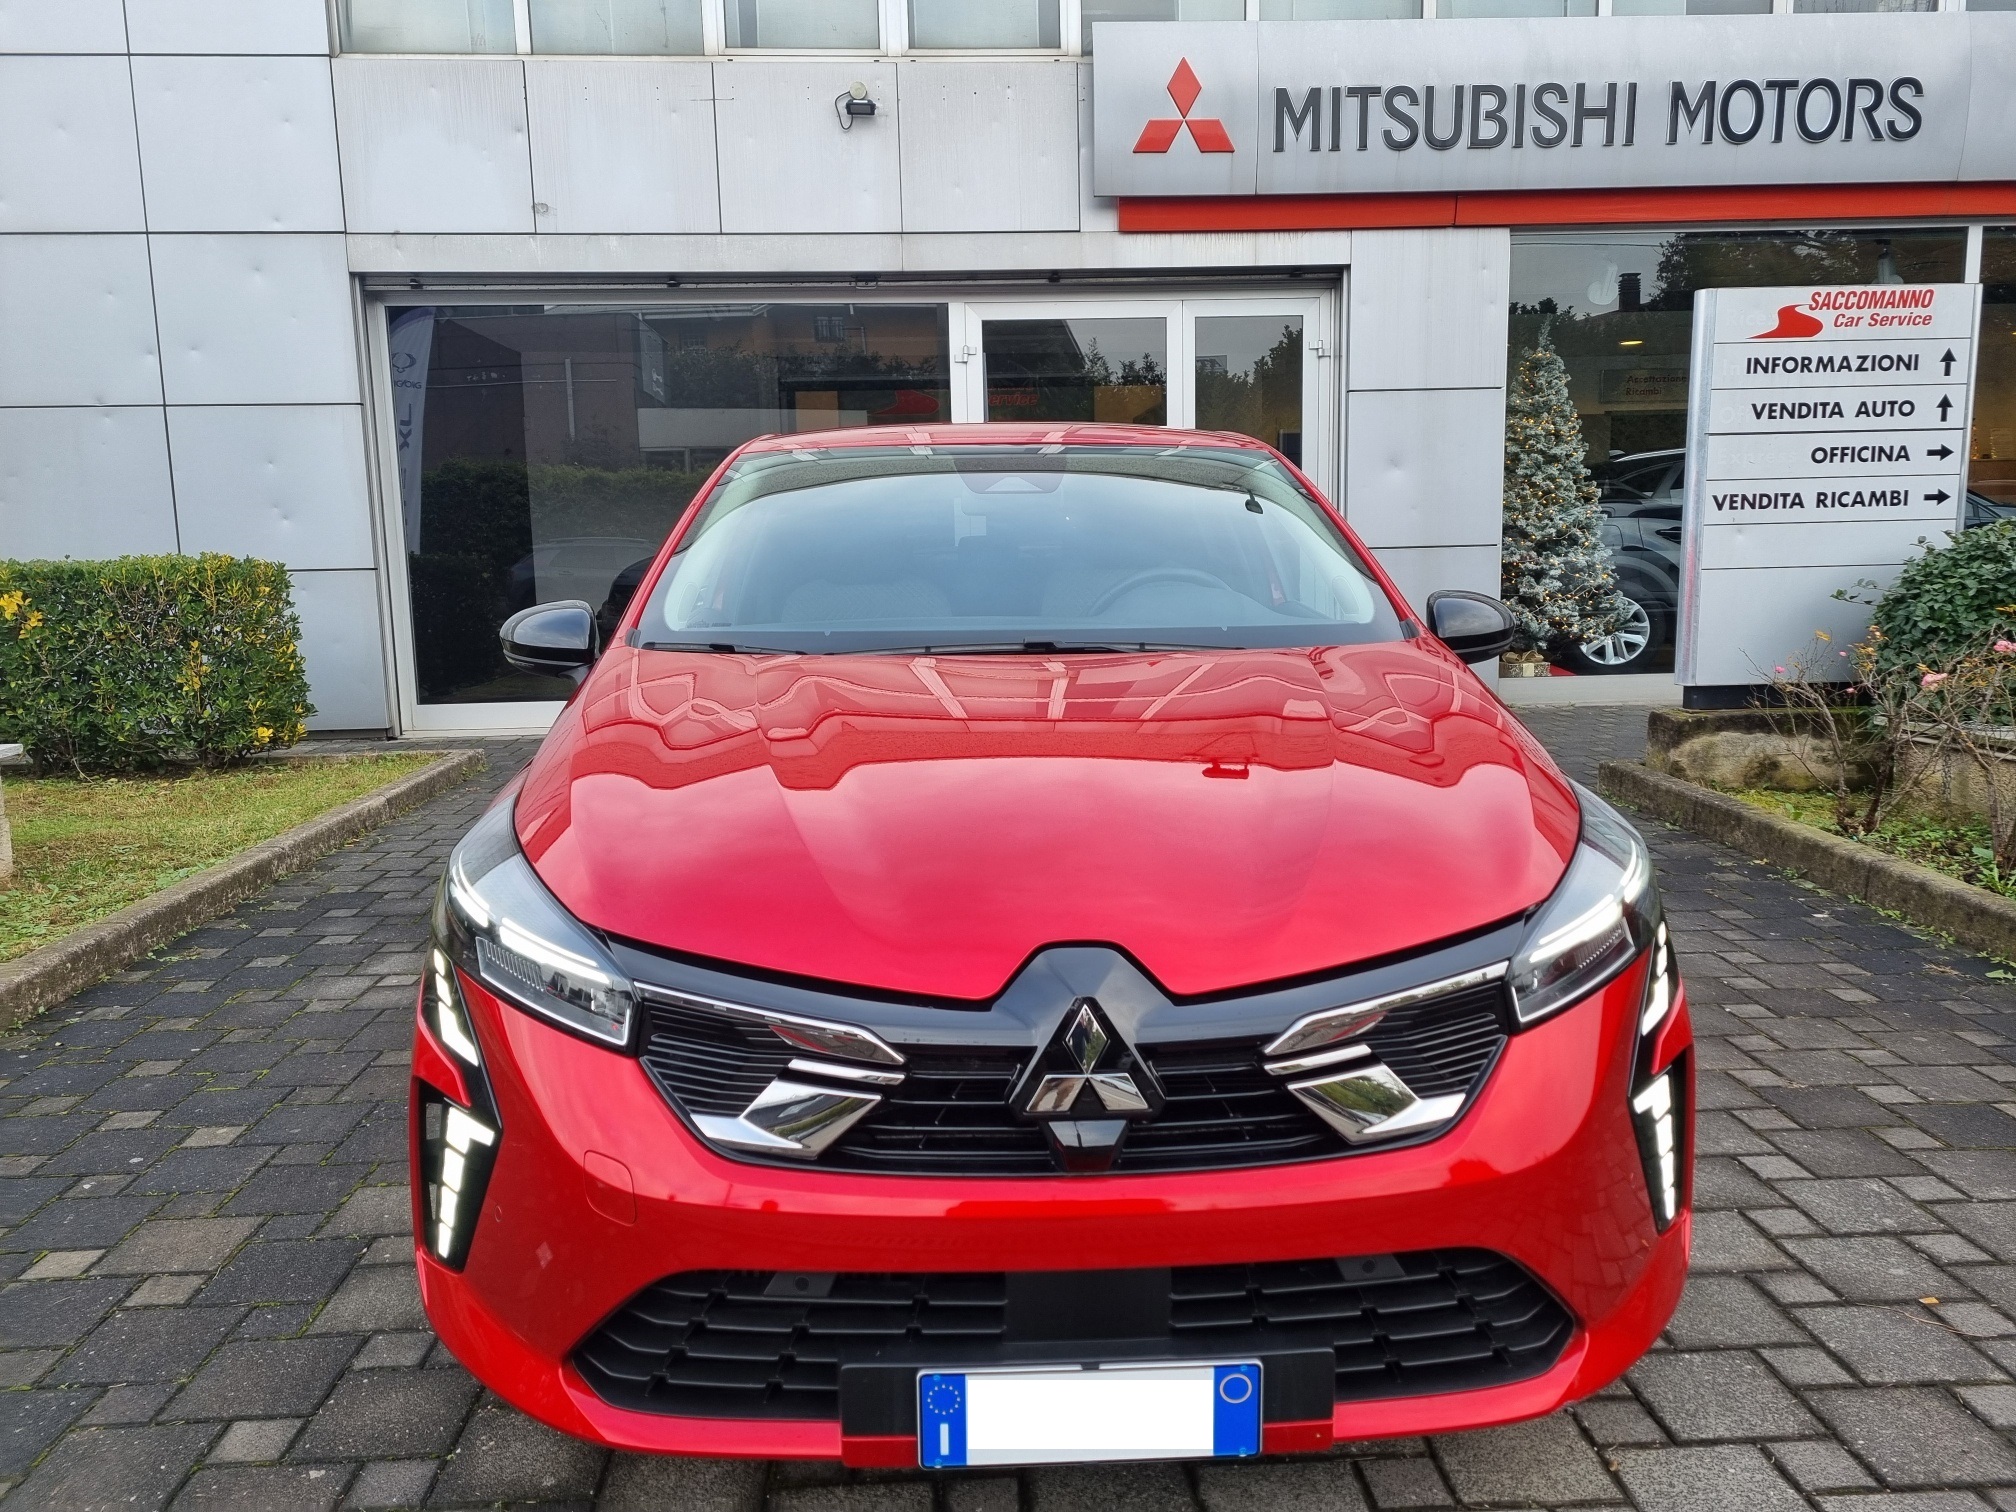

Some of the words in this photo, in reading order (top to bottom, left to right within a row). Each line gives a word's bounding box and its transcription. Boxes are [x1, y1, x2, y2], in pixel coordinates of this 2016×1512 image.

[1271, 81, 1638, 154] MITSUBISHI
[1665, 76, 1924, 146] MOTORS
[1808, 288, 1935, 311] SACCOMANNO
[1833, 313, 1864, 328] Car
[1867, 311, 1933, 327] Service
[1745, 353, 1920, 375] INFORMAZIONI
[989, 392, 1038, 405] ervice
[1625, 386, 1663, 396] Ricambi
[1751, 401, 1845, 420] VENDITA
[1854, 399, 1916, 418] AUTO
[1810, 445, 1911, 464] OFFICINA
[1712, 492, 1805, 512] VENDITA
[1815, 489, 1910, 508] RICAMBI
[939, 1423, 949, 1456] I
